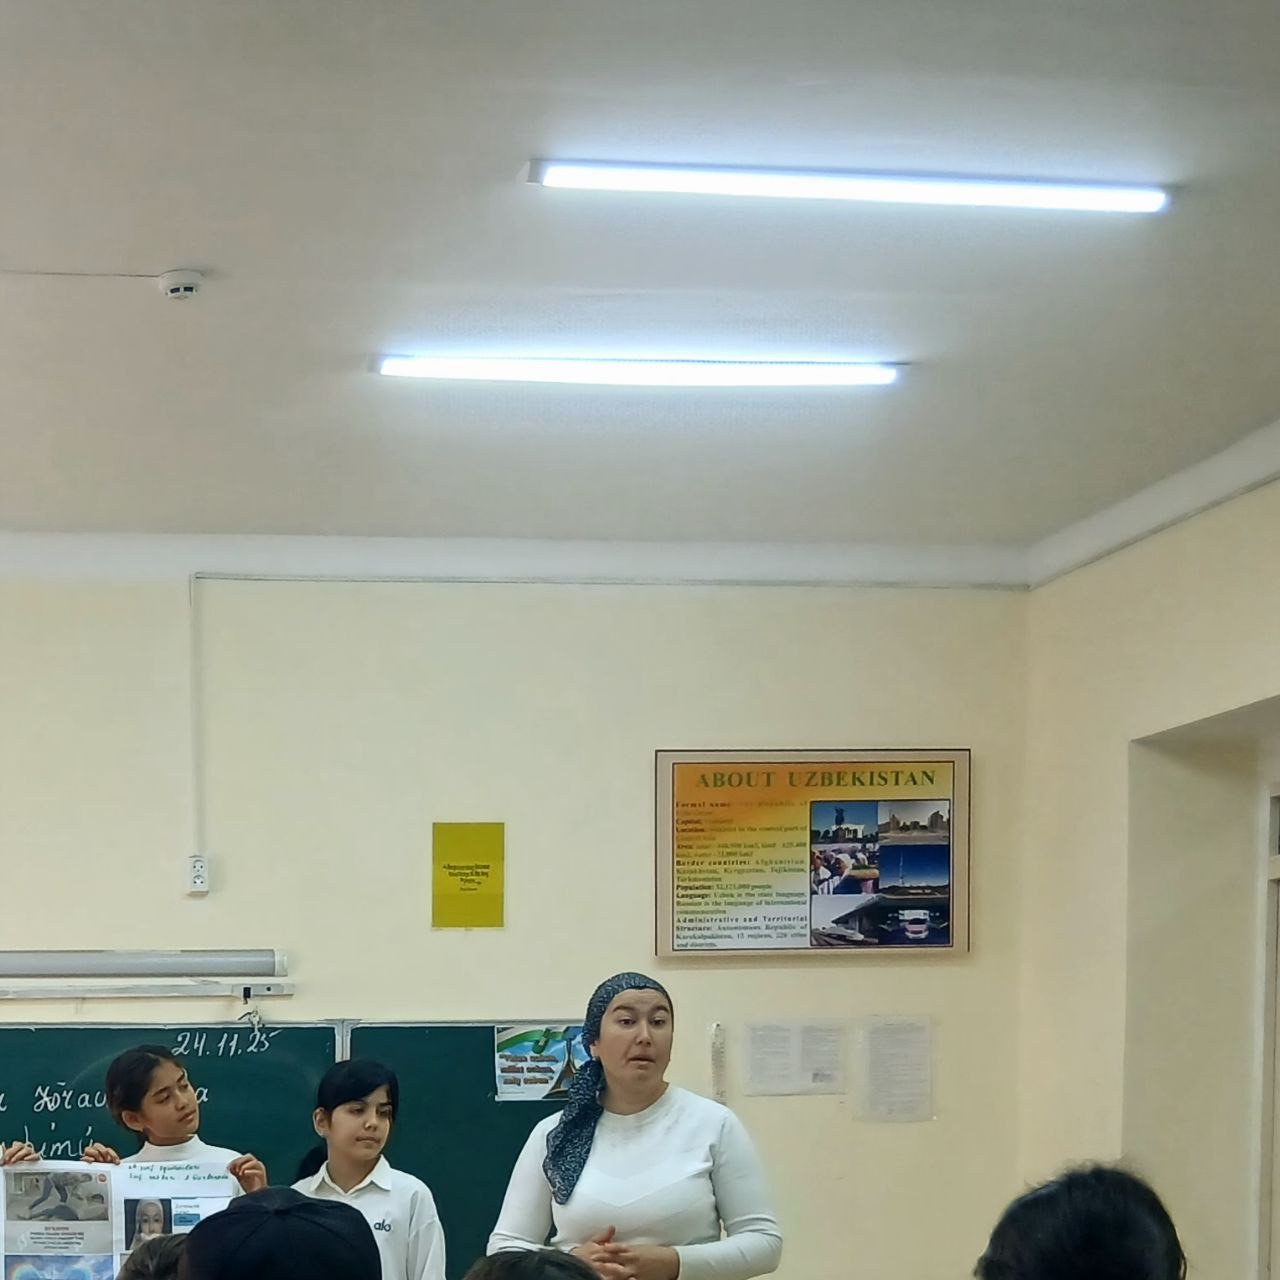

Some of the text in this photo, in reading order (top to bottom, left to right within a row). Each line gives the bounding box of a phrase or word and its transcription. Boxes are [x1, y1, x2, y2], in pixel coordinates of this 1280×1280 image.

[697, 769, 936, 788] ABOUT UZBEKISTAN
[172, 1030, 284, 1058] 24.11.25
